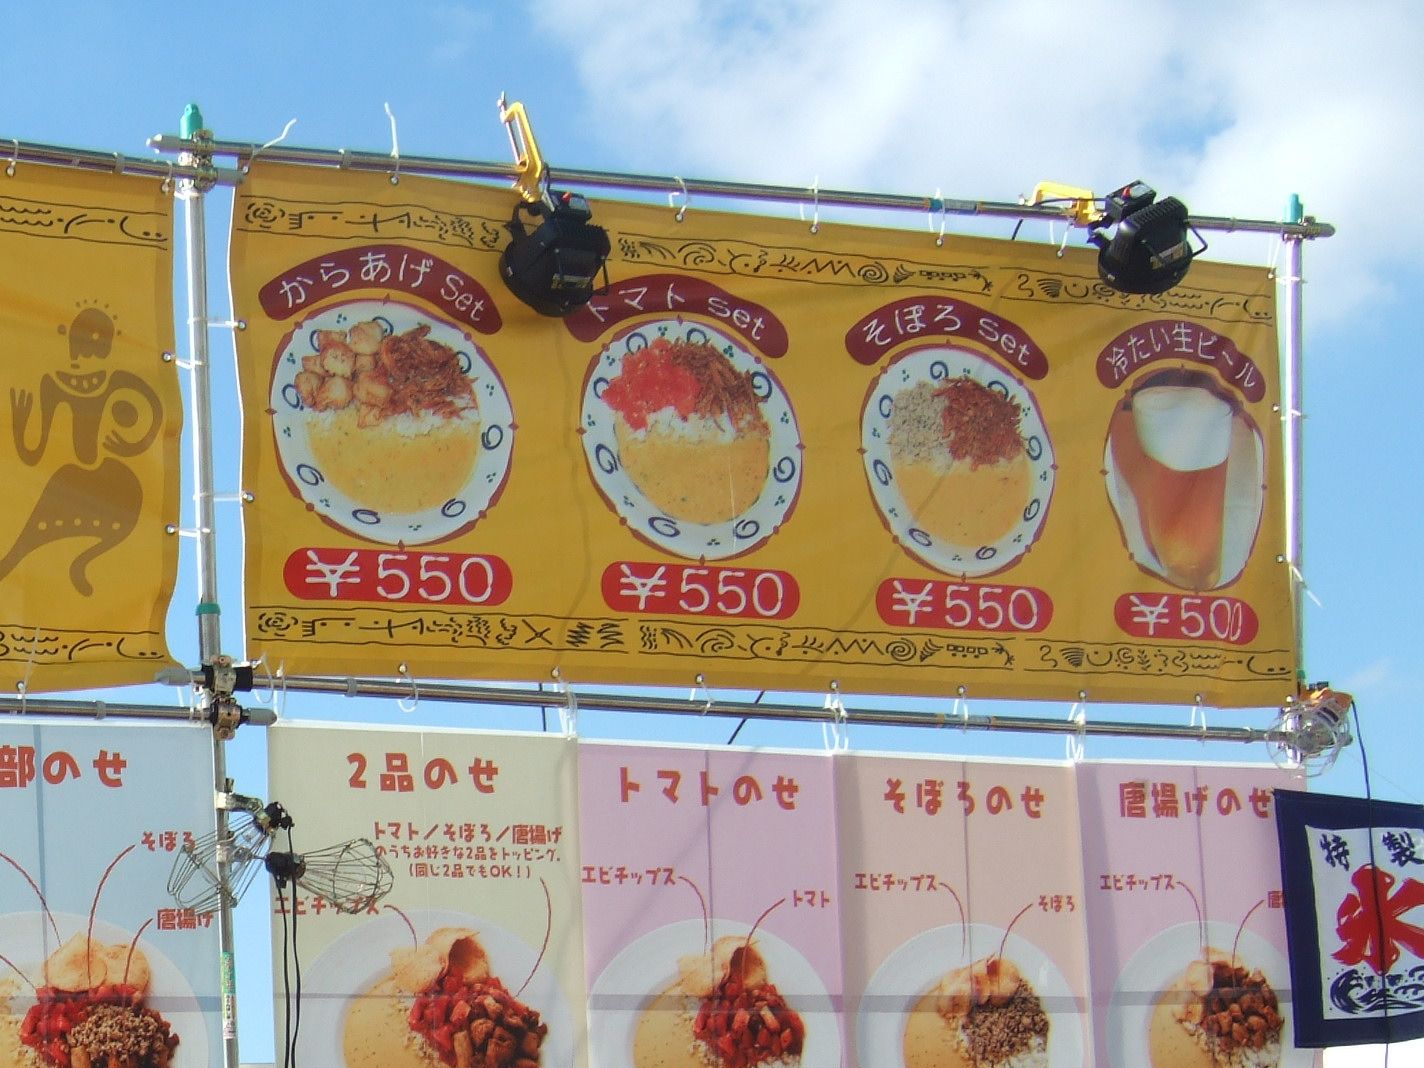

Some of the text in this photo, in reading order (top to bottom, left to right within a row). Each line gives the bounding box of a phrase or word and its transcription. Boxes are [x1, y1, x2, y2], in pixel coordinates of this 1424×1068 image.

[278, 252, 436, 309] からあげ
[585, 282, 688, 323] トマト
[862, 303, 962, 347] そぼろ
[1105, 321, 1256, 388] 冷たい生ビール
[346, 752, 500, 794] 2品のせ
[619, 766, 800, 811] トマトのせ
[883, 777, 1045, 819] そぼろのせ
[1119, 782, 1274, 819] 唐揚げのせ
[582, 866, 677, 887] エビチップス
[854, 873, 937, 891] エビチップス
[1100, 874, 1176, 891] エビチップス
[792, 890, 831, 908] トマト
[1038, 894, 1076, 913] そぼろ
